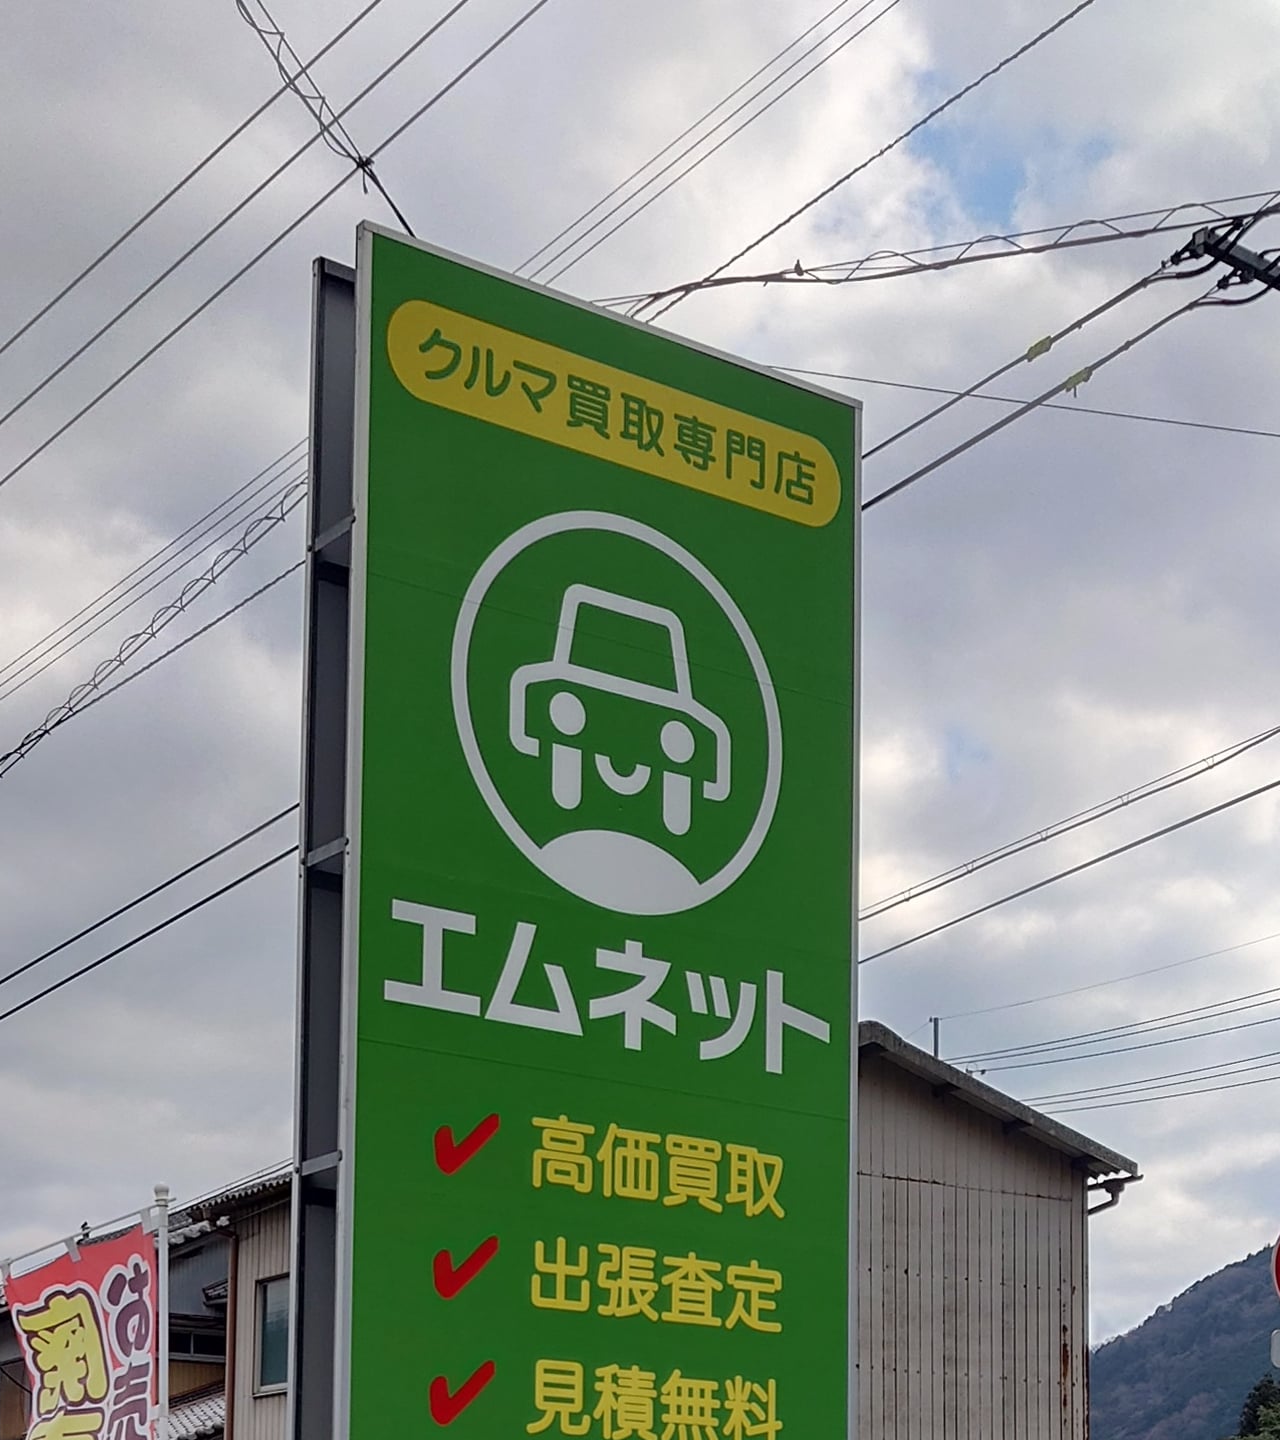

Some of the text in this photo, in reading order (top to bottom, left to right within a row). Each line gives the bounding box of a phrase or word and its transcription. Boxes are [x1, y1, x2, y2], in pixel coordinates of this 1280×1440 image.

[419, 327, 818, 507] クルマ買取専門店
[383, 897, 831, 1075] エムネット
[530, 1114, 786, 1220] 高価買取
[530, 1236, 783, 1333] 出張査定
